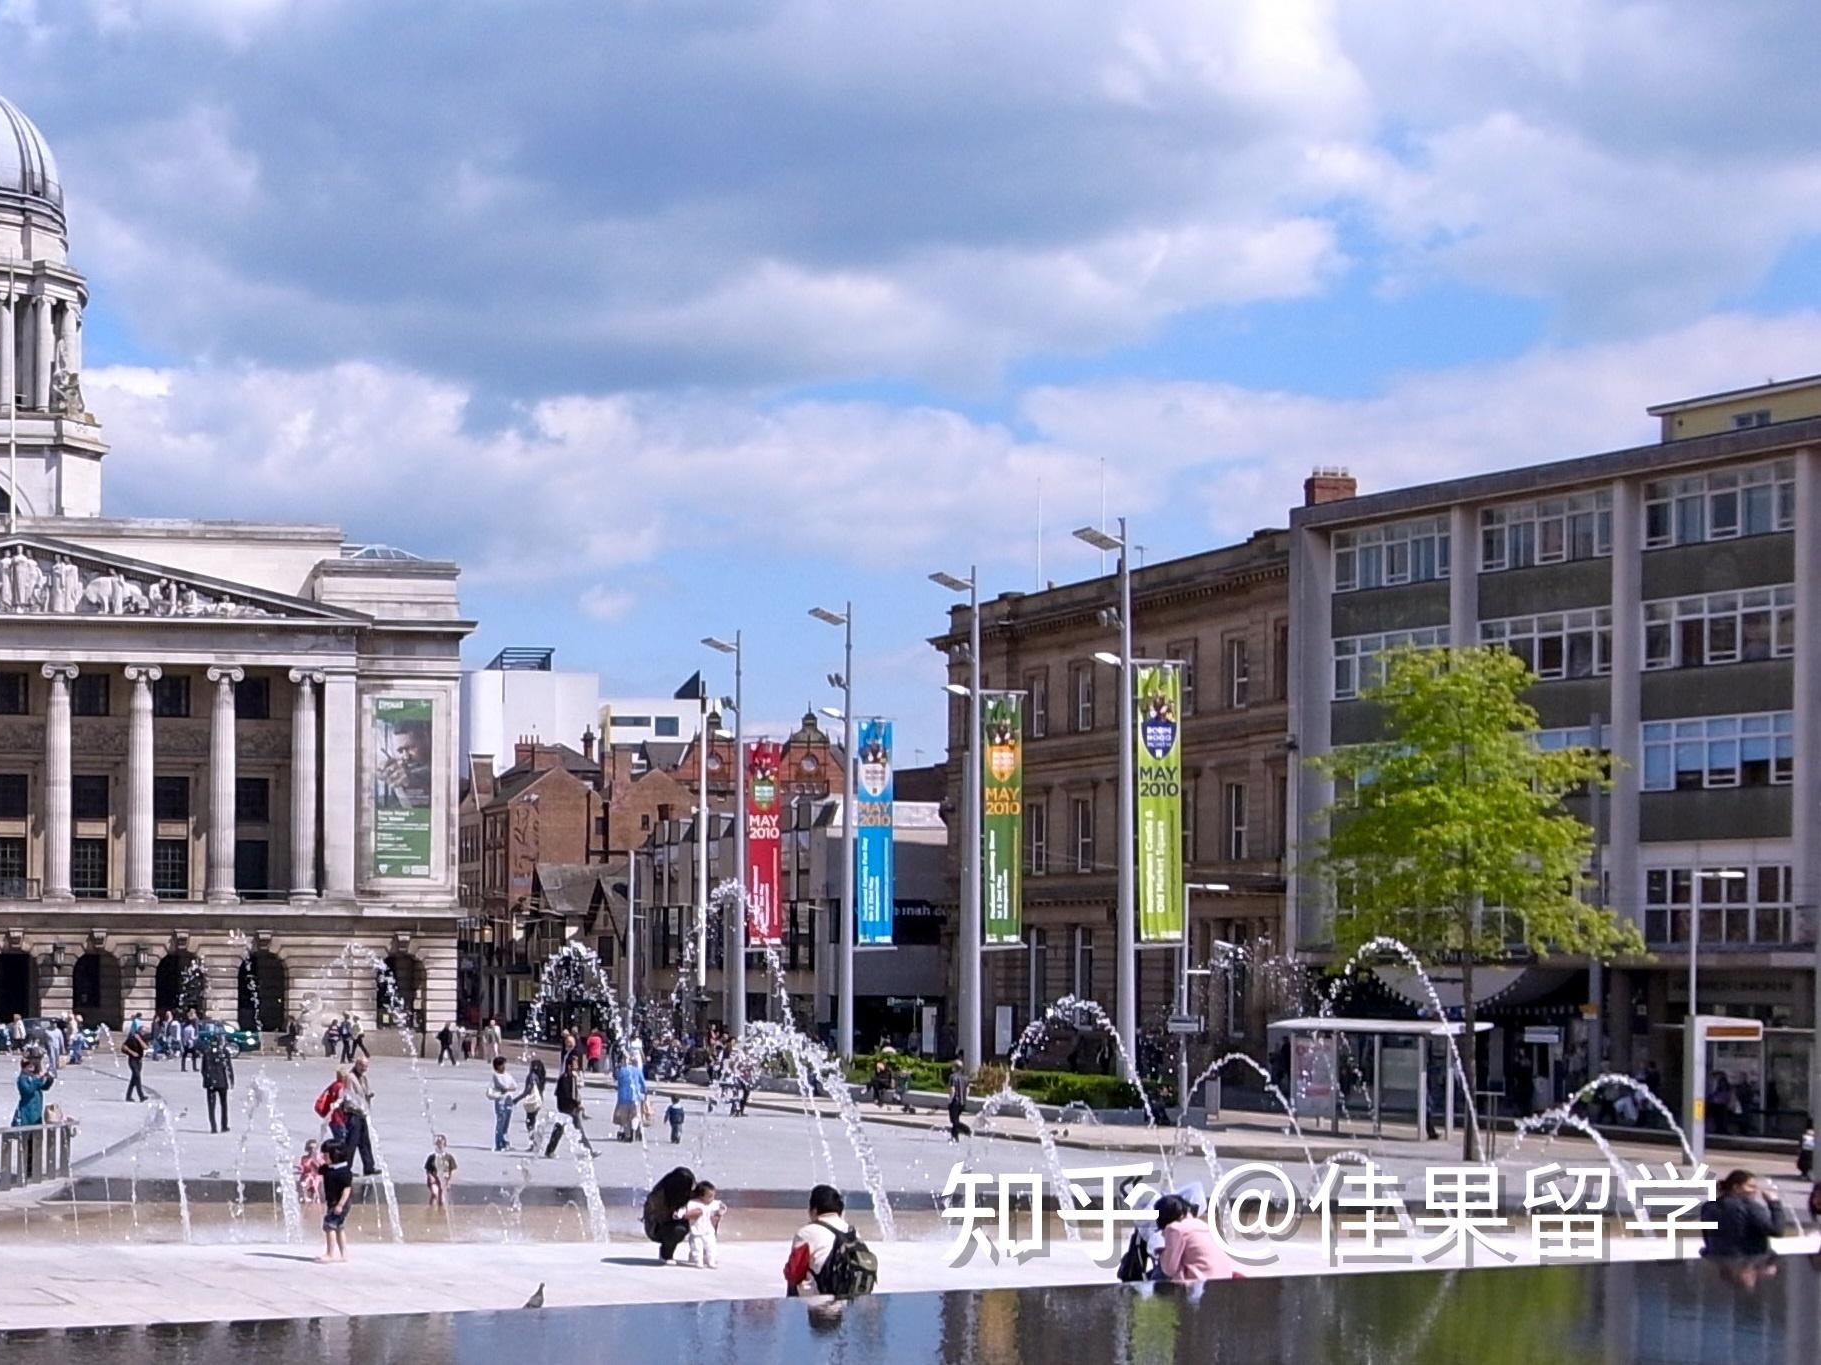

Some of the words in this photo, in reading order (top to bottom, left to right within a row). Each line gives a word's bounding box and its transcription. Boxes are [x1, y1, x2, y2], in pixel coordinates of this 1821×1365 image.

[1139, 767, 1177, 781] MAY
[985, 787, 1020, 801] MAY
[1139, 782, 1178, 797] 2010
[985, 801, 1021, 815] 2010
[749, 814, 779, 827] MAY
[749, 827, 780, 839] 2010
